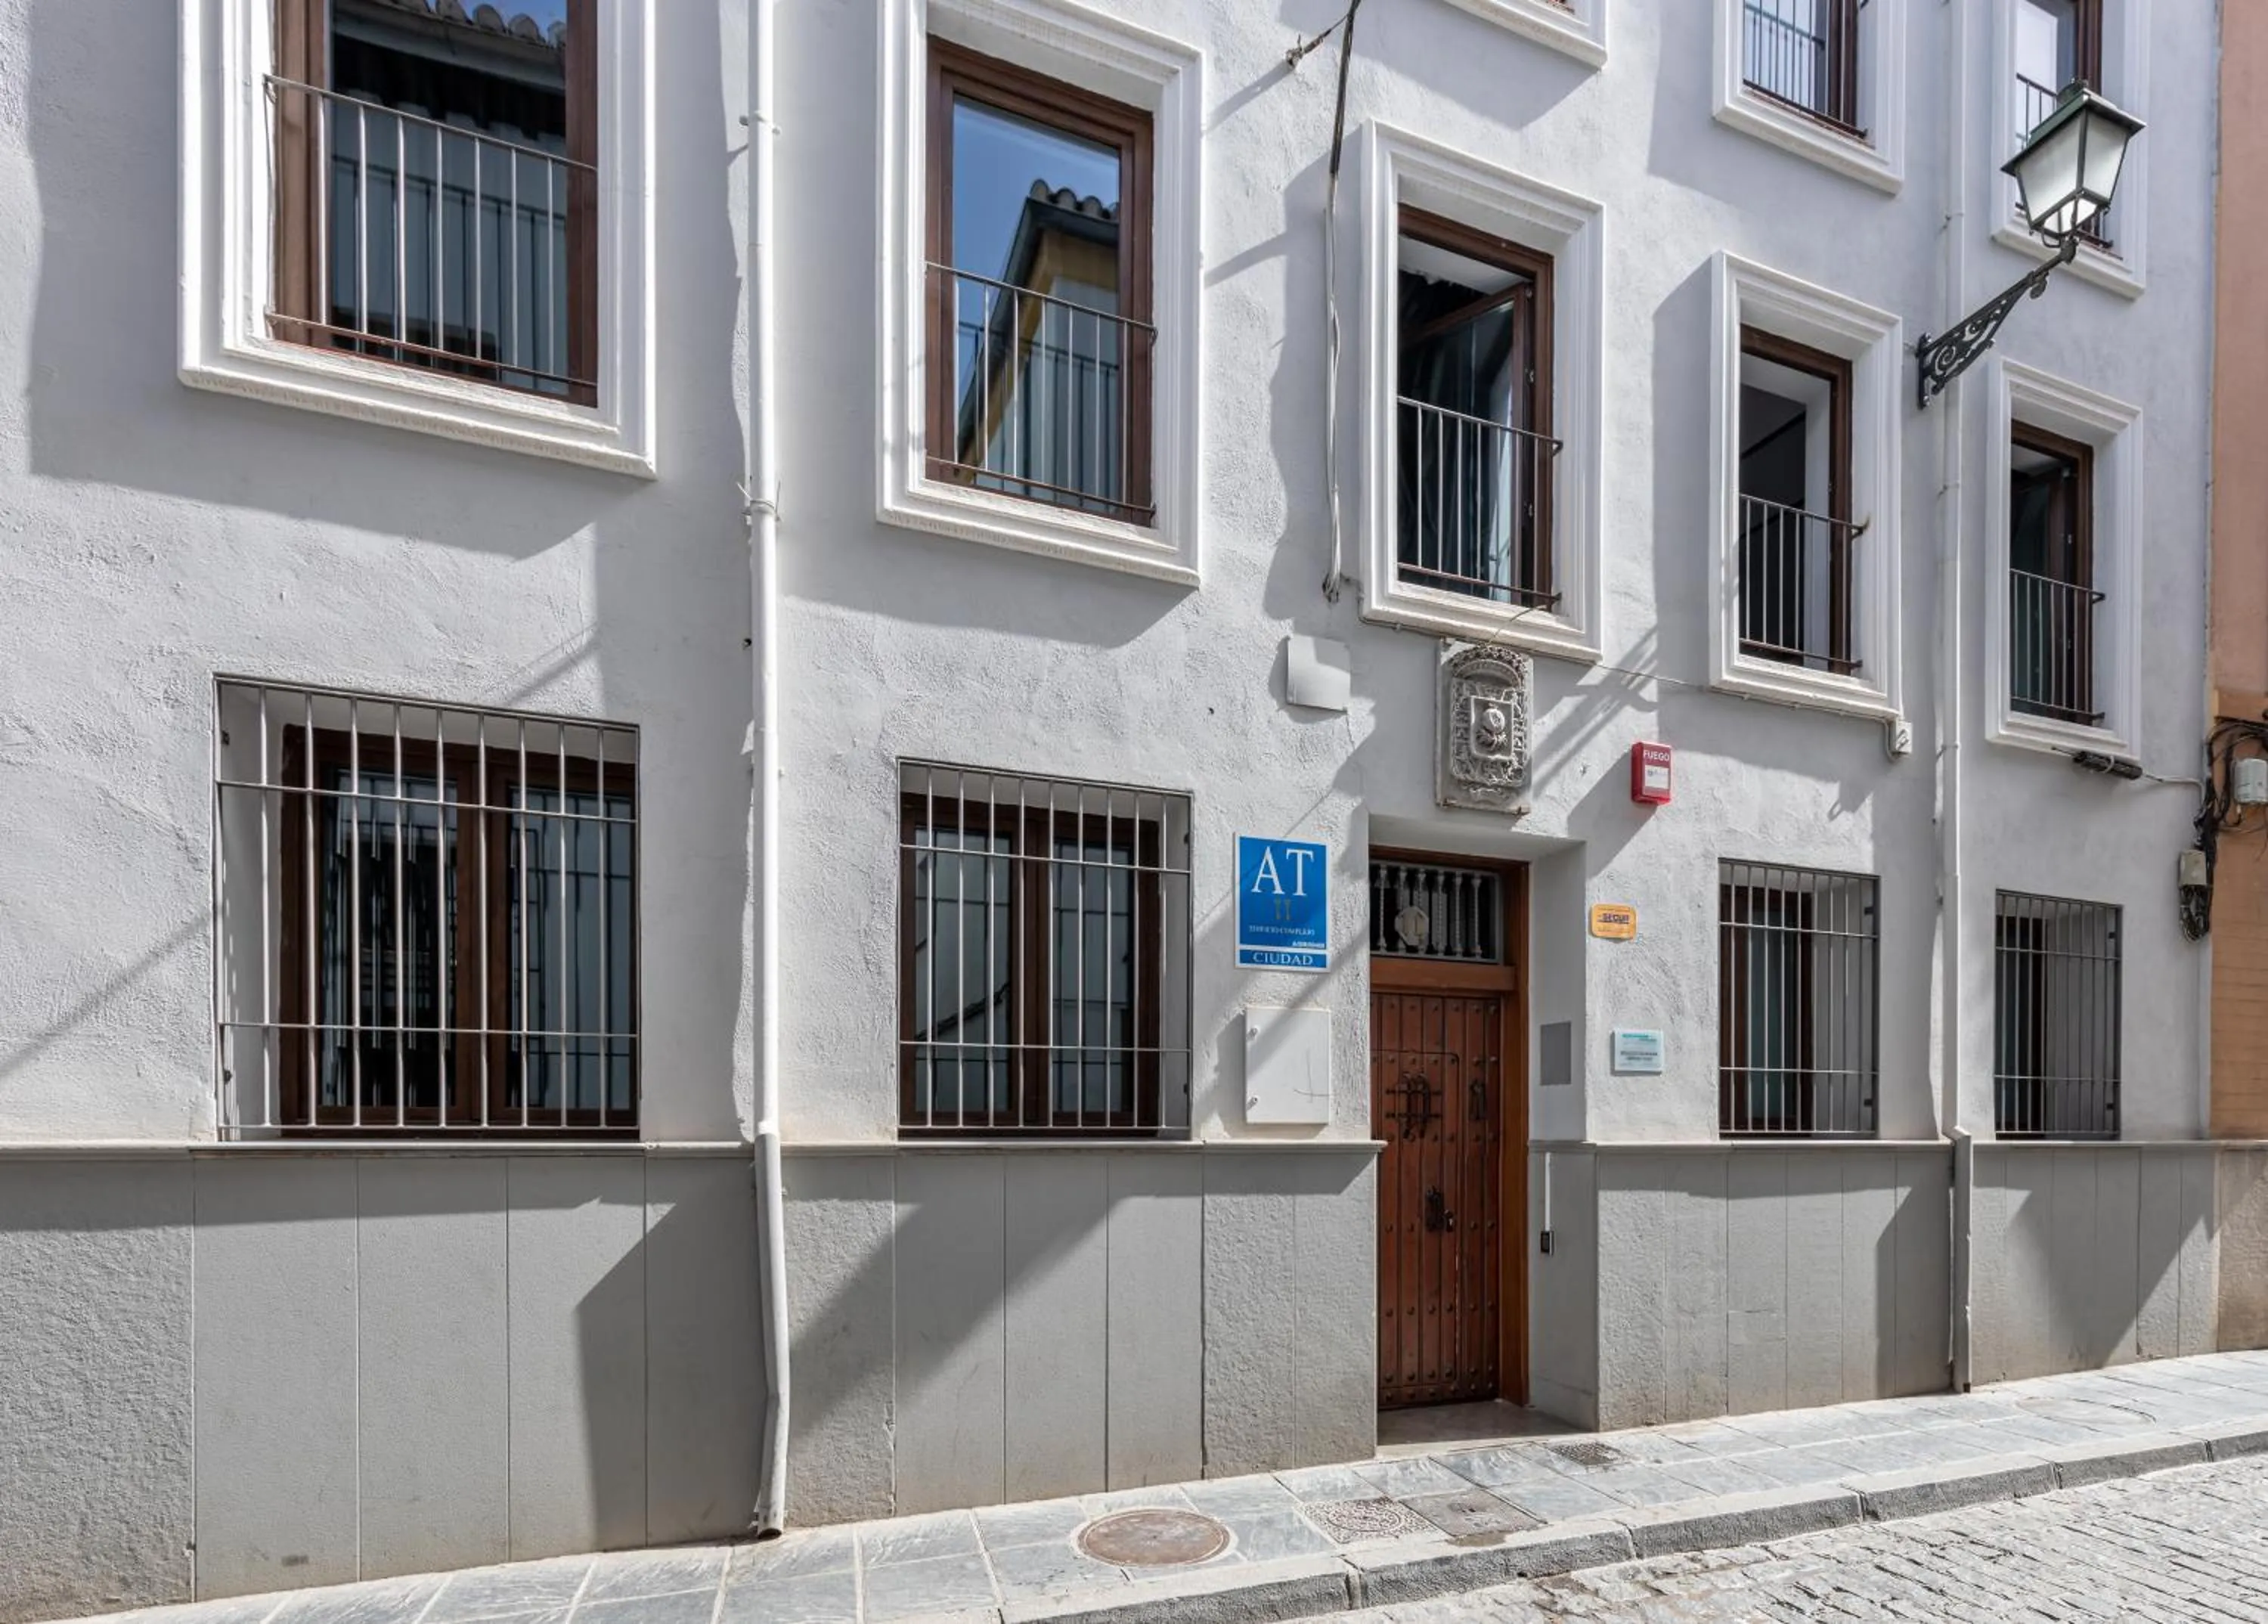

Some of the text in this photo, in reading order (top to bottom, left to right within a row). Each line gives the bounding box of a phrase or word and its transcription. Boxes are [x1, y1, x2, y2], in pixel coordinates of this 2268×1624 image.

[1643, 749, 1670, 762] FUEGO
[1250, 845, 1315, 896] AT
[1253, 951, 1313, 965] CIUDAD
